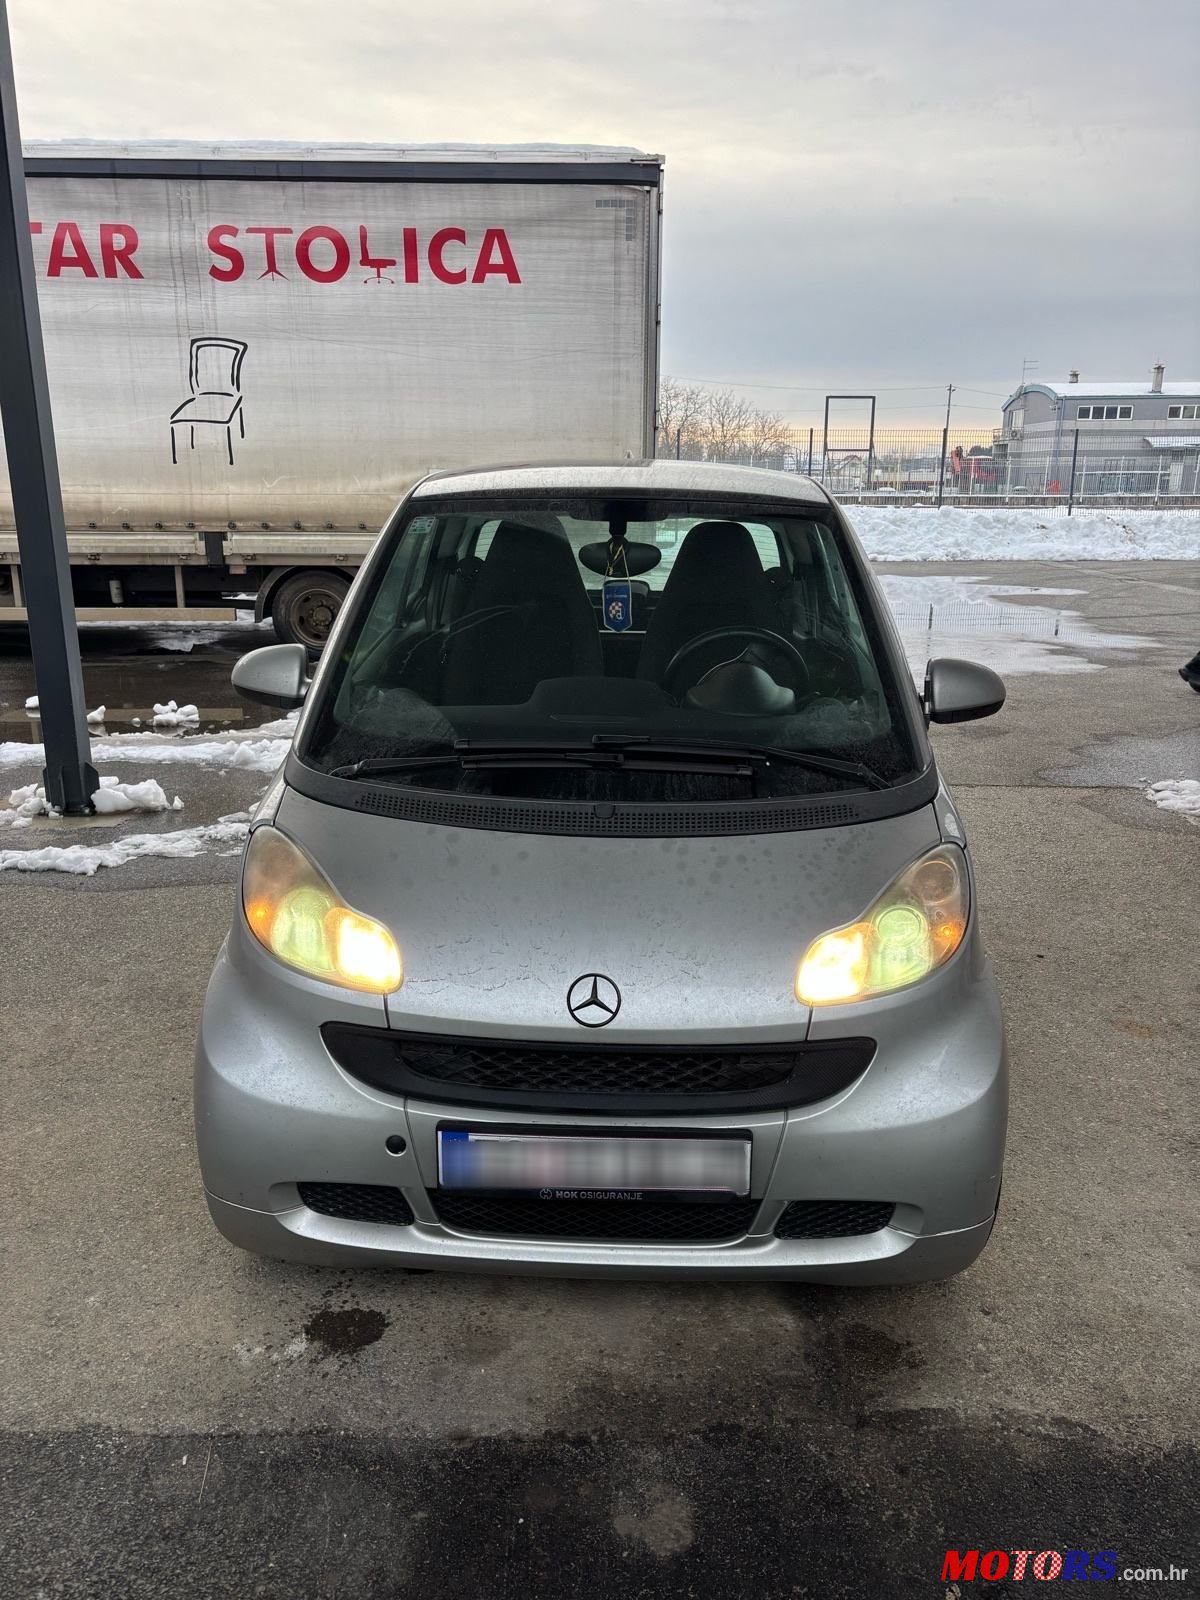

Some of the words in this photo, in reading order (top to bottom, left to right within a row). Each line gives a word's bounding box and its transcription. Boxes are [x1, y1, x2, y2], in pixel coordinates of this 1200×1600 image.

[207, 224, 522, 284] STOLICA
[555, 1190, 578, 1200] HOK
[580, 1191, 644, 1201] OSIGURANJE
